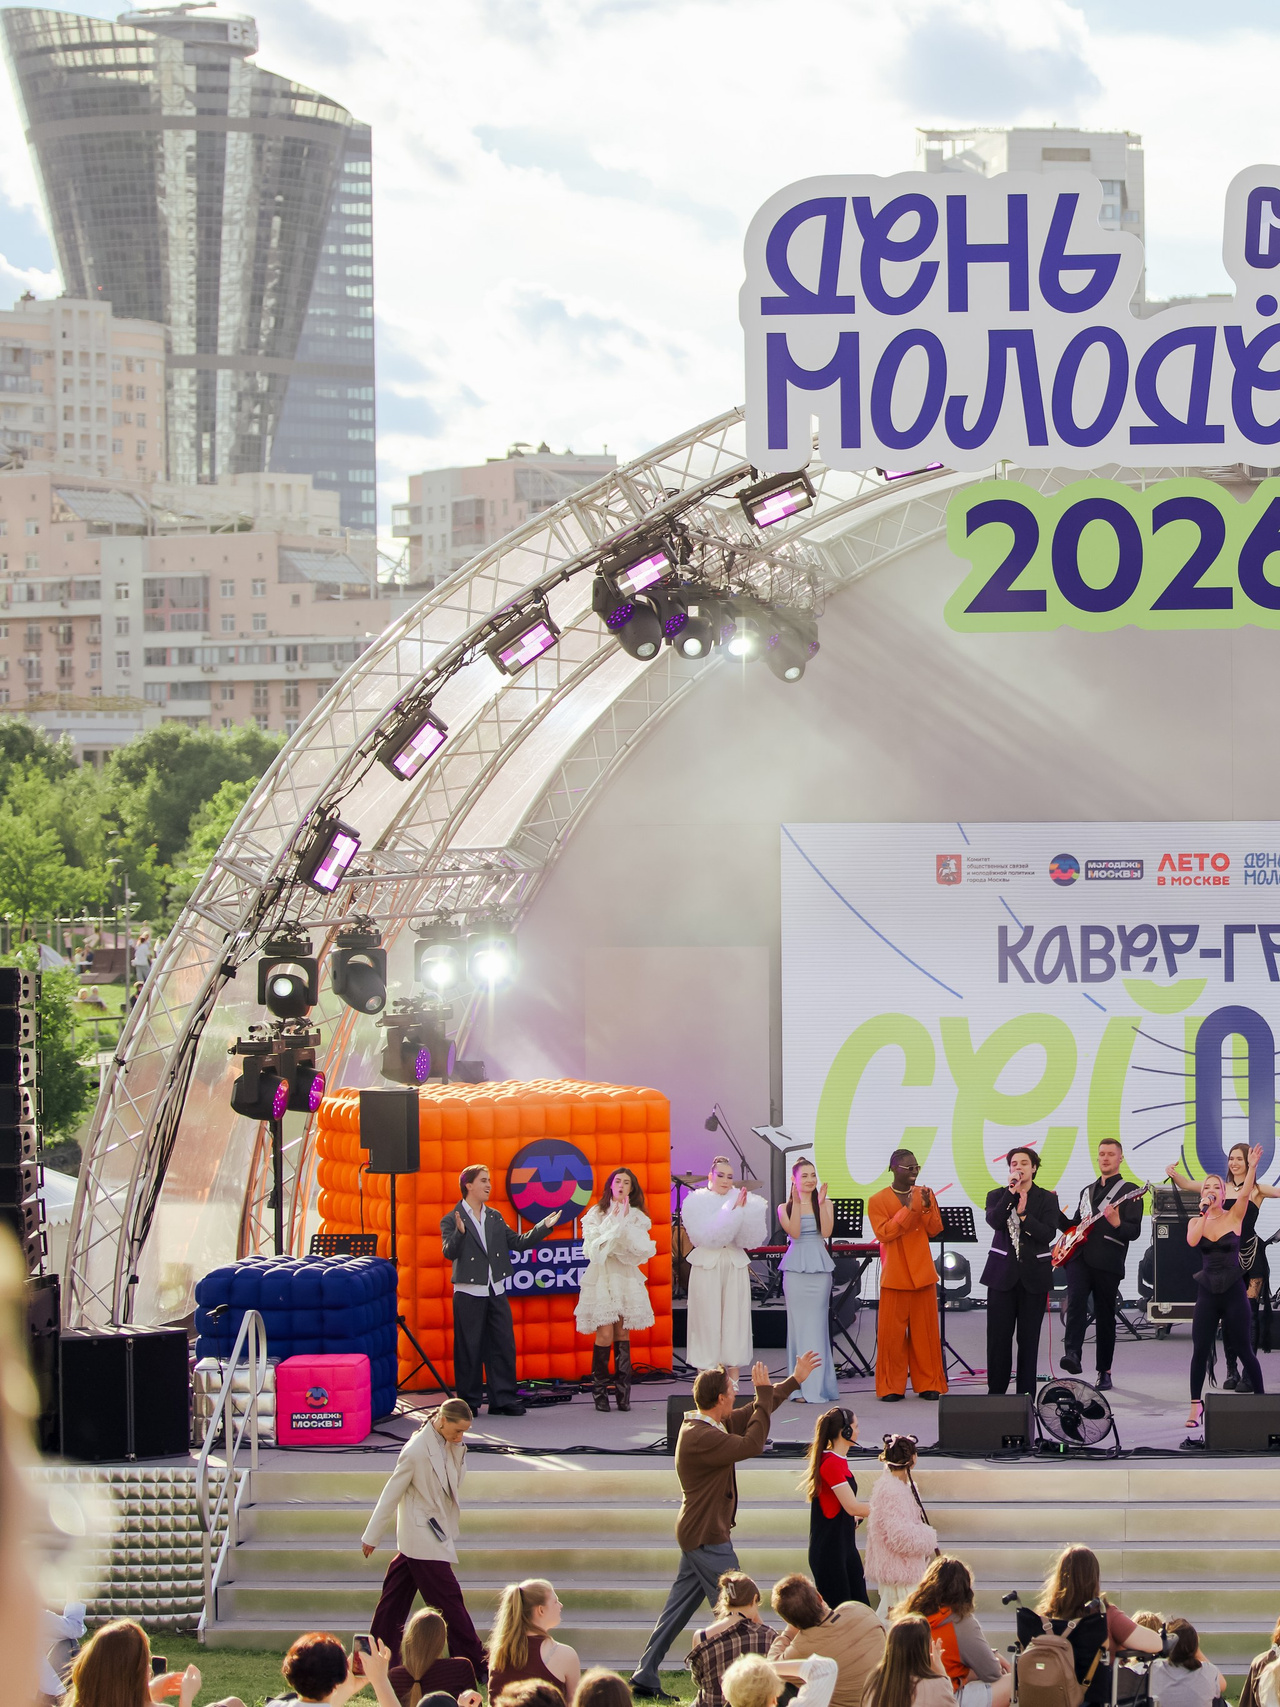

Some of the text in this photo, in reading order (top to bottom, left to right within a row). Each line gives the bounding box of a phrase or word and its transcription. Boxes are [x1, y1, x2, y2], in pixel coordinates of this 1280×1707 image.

[1157, 852, 1231, 872] ЛЕТО
[1157, 876, 1230, 886] В МОСКВЕ
[292, 1420, 342, 1428] МОСКВЫ
